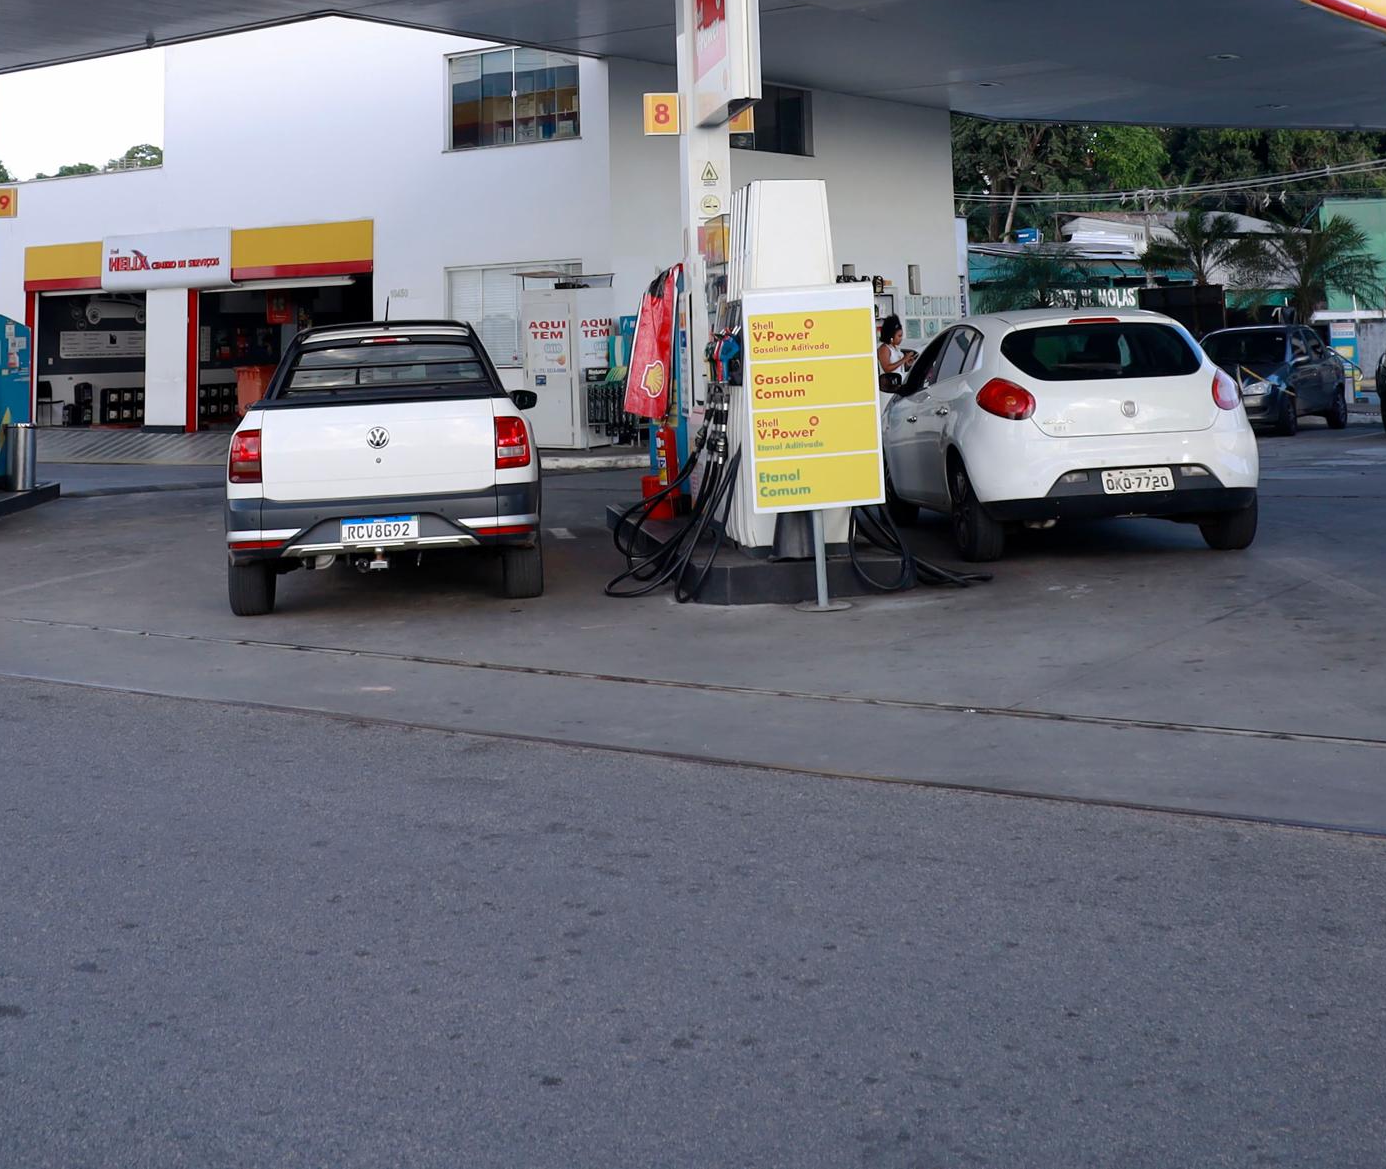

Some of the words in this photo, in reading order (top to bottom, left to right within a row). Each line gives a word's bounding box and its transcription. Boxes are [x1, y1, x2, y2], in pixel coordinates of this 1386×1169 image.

[654, 104, 670, 124] 8
[109, 250, 150, 272] HELIX
[1098, 288, 1136, 308] MOLAS
[529, 320, 566, 330] AQUI
[580, 318, 612, 328] AQUI
[752, 321, 774, 330] Shell
[583, 329, 610, 338] TEM
[753, 331, 810, 343] V-Power
[753, 345, 789, 354] Gasolina
[754, 372, 814, 385] Gasolina
[755, 388, 806, 399] Comum
[756, 419, 779, 428] Shell
[757, 428, 815, 440] V-Power
[757, 443, 783, 452] Etanol
[759, 469, 800, 483] Etanol
[760, 485, 811, 498] Comum
[347, 522, 410, 540] RCV8G92
